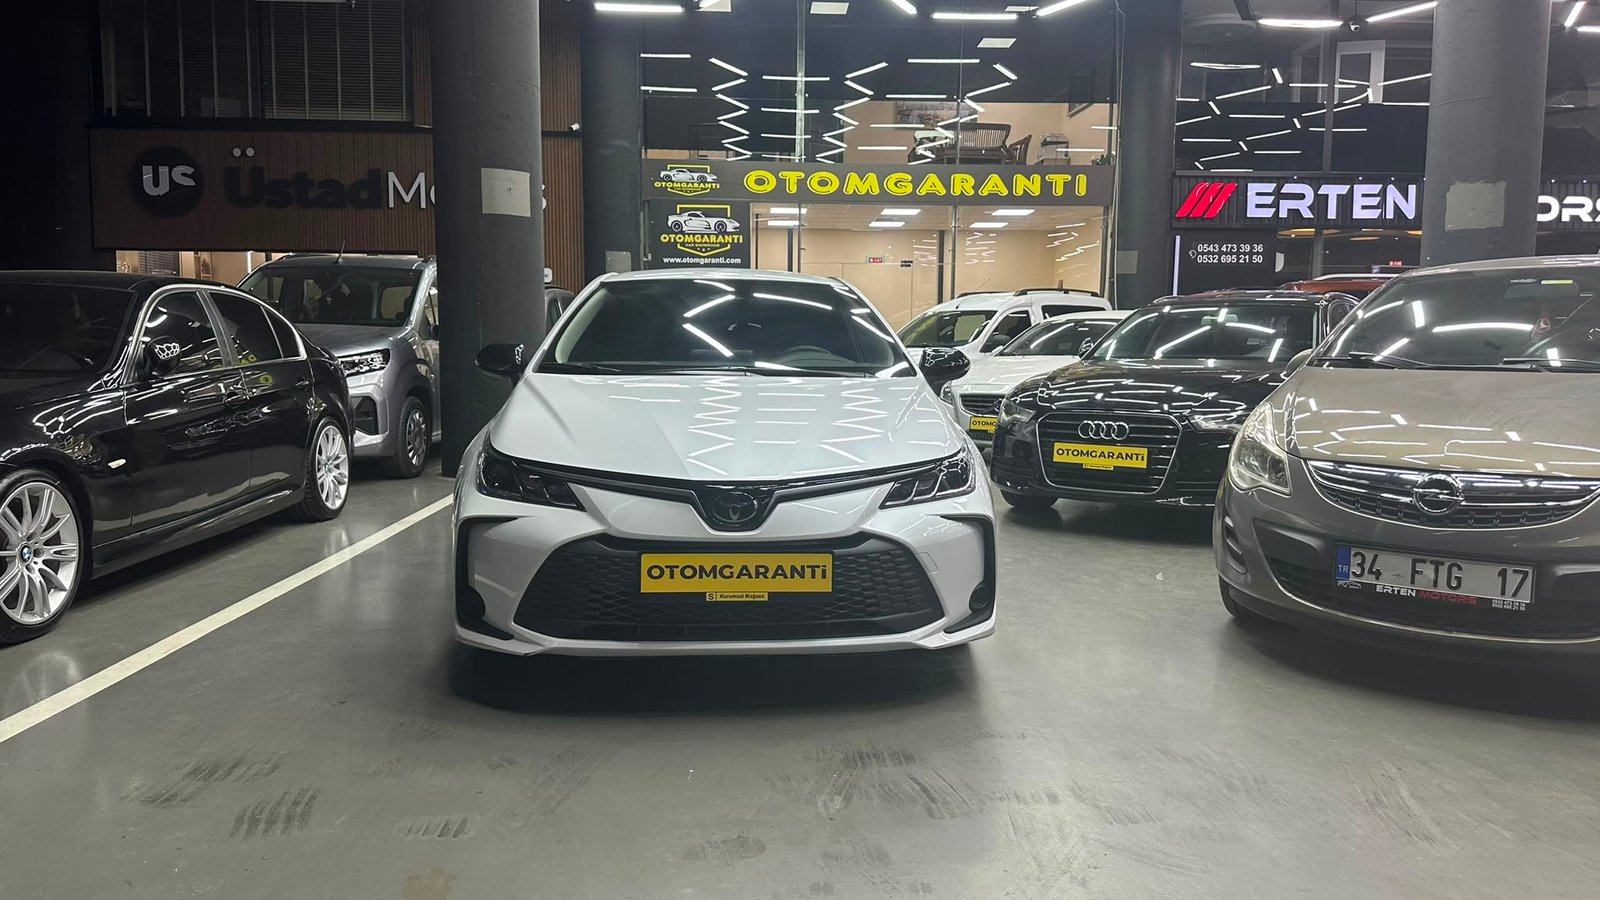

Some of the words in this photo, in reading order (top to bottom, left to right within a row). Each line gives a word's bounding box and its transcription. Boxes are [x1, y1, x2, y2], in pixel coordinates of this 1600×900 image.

[743, 169, 1088, 196] OTOMGARANTI
[1246, 182, 1416, 220] ERTEN
[660, 234, 743, 243] OTOMGARANTI
[1197, 244, 1219, 252] 0543
[1220, 244, 1237, 252] 473
[1240, 244, 1250, 252] 39
[1252, 244, 1263, 252] 36
[1197, 255, 1219, 263] 0532
[1220, 255, 1237, 263] 695
[1239, 255, 1249, 263] 21
[1252, 255, 1263, 263] 50
[1056, 448, 1145, 462] OTOMGARANTi
[646, 564, 826, 580] OTOMGARANTi
[1337, 564, 1349, 573] TR
[1352, 551, 1382, 580] 34
[1410, 558, 1463, 590] FTG
[1497, 568, 1529, 597] 17
[1376, 584, 1416, 597] ERTEN
[1419, 590, 1477, 604] MOTORS
